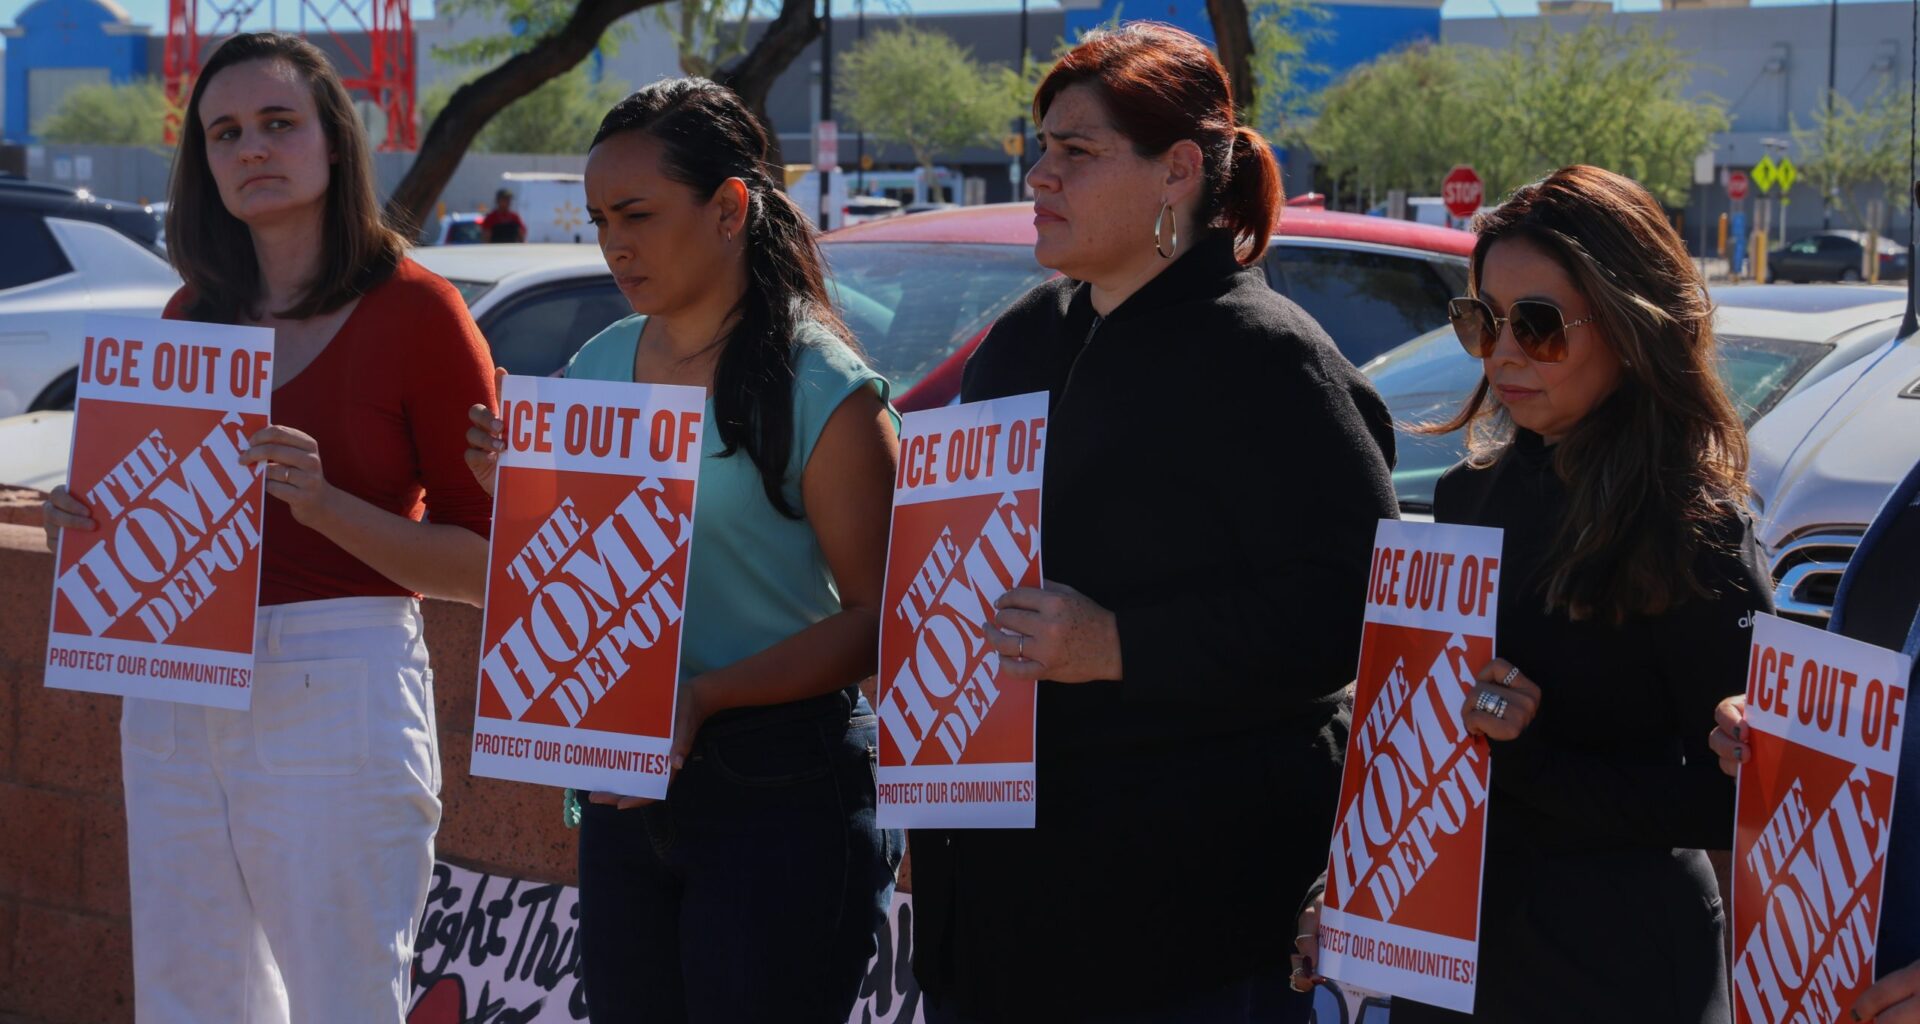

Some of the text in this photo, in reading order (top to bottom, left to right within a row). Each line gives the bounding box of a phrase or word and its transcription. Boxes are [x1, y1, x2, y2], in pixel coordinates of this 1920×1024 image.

[1445, 181, 1482, 204] STOP
[81, 336, 272, 399] ICE OUT OF
[86, 428, 178, 520] THE
[503, 400, 702, 463] ICE OUT OF
[896, 417, 1046, 490] ICE OUT OF
[57, 411, 267, 636] HOME
[135, 501, 261, 644] DEPOT
[506, 496, 589, 596] THE
[480, 475, 692, 721] HOME
[878, 490, 1040, 766] HOME
[896, 525, 962, 634] THE
[1367, 547, 1499, 617] ICE OUT OF
[49, 647, 251, 689] PROTECT OUR COMMUNITIES!
[550, 572, 683, 728] DEPOT
[1747, 643, 1905, 752] ICE OUT OF
[474, 732, 670, 775] PROTECT OUR COMMUNITIES!
[934, 650, 1001, 765] DEP
[1356, 655, 1411, 769] THE
[878, 780, 1034, 804] PROTECT OUR COMMUNITIES!
[1330, 633, 1476, 911] HOME
[1367, 746, 1487, 922] DEPOT
[1746, 776, 1812, 896] THE
[1733, 763, 1889, 1024] HOME
[1352, 934, 1375, 962] OUR
[1377, 941, 1475, 985] COMMUNITIES!
[1789, 893, 1875, 1024] EPOT
